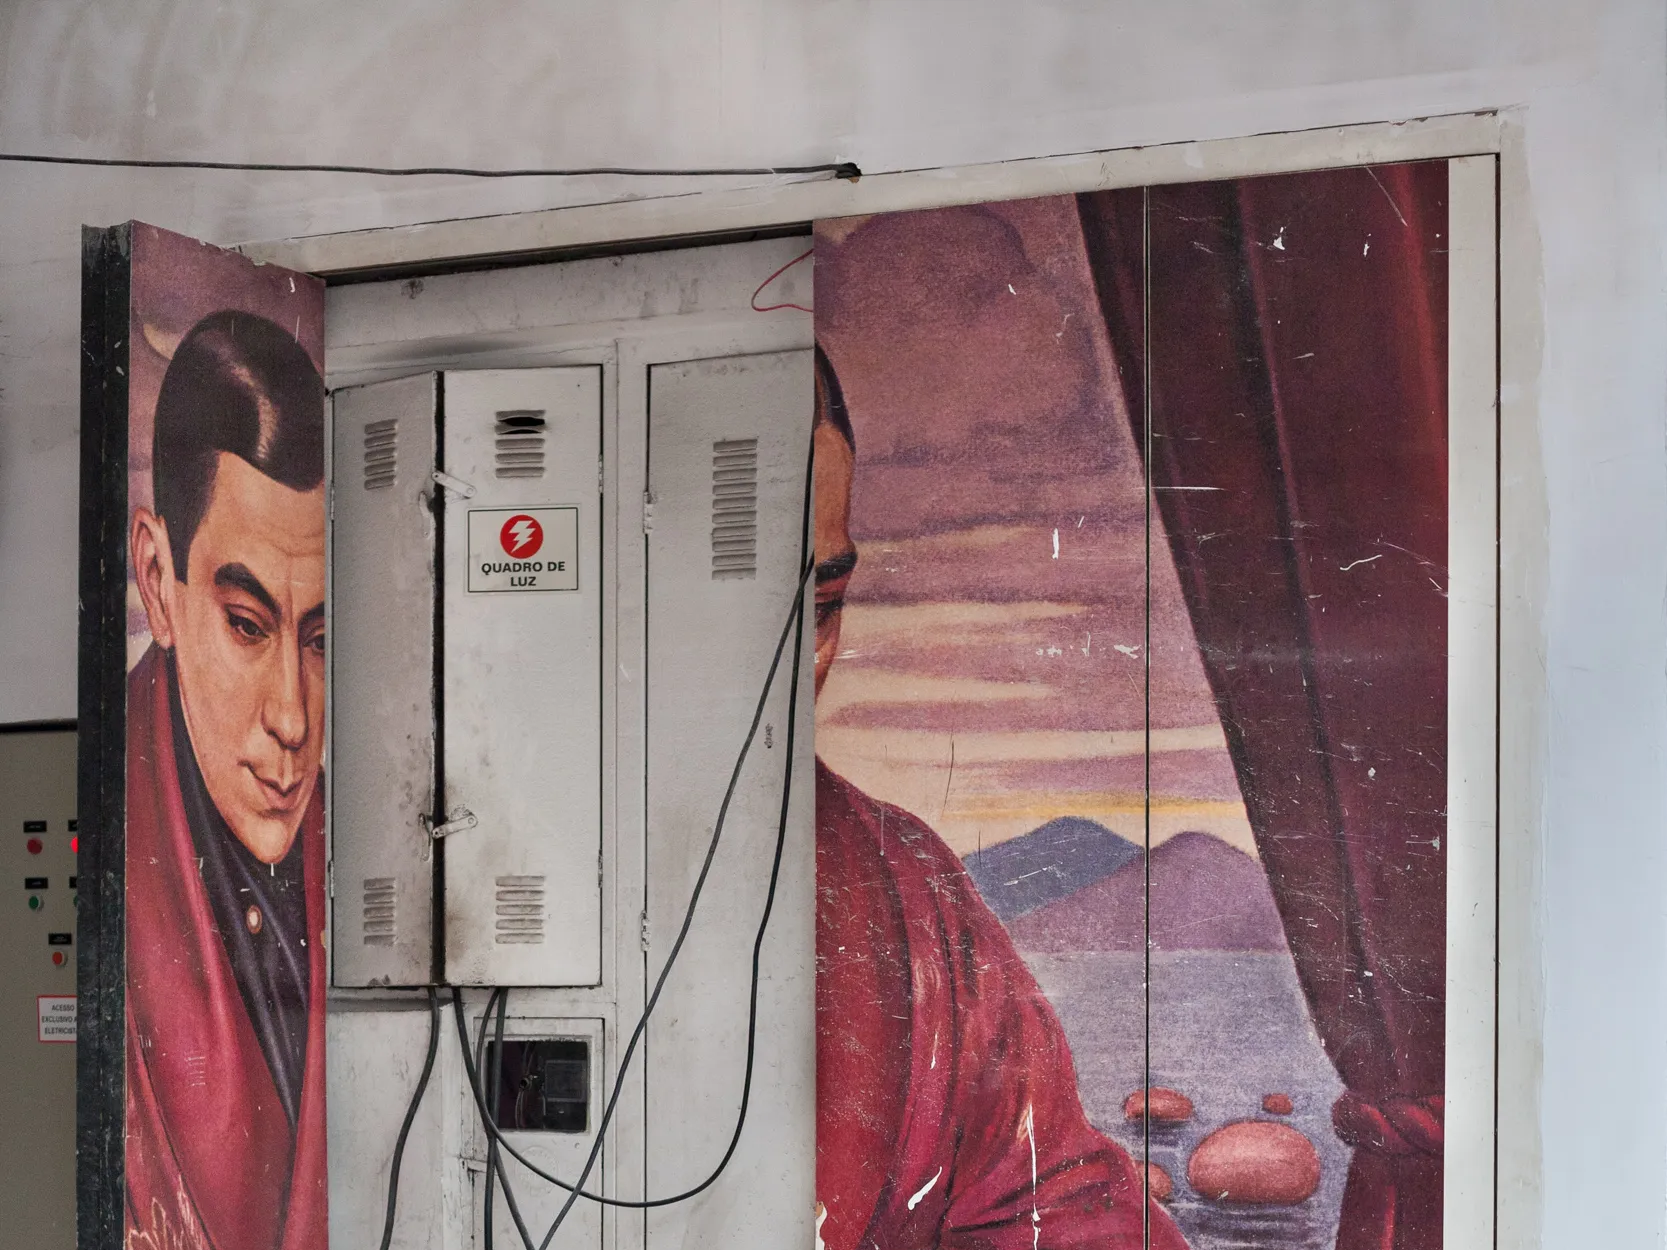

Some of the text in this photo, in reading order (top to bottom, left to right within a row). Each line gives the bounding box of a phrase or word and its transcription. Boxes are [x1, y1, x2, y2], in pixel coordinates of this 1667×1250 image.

[481, 561, 566, 576] QUADRO DE
[510, 576, 537, 587] LUZ
[51, 1003, 75, 1012] ACESSO
[41, 1015, 73, 1023] EXCLUSIVO
[44, 1027, 77, 1035] ELETRICIST
